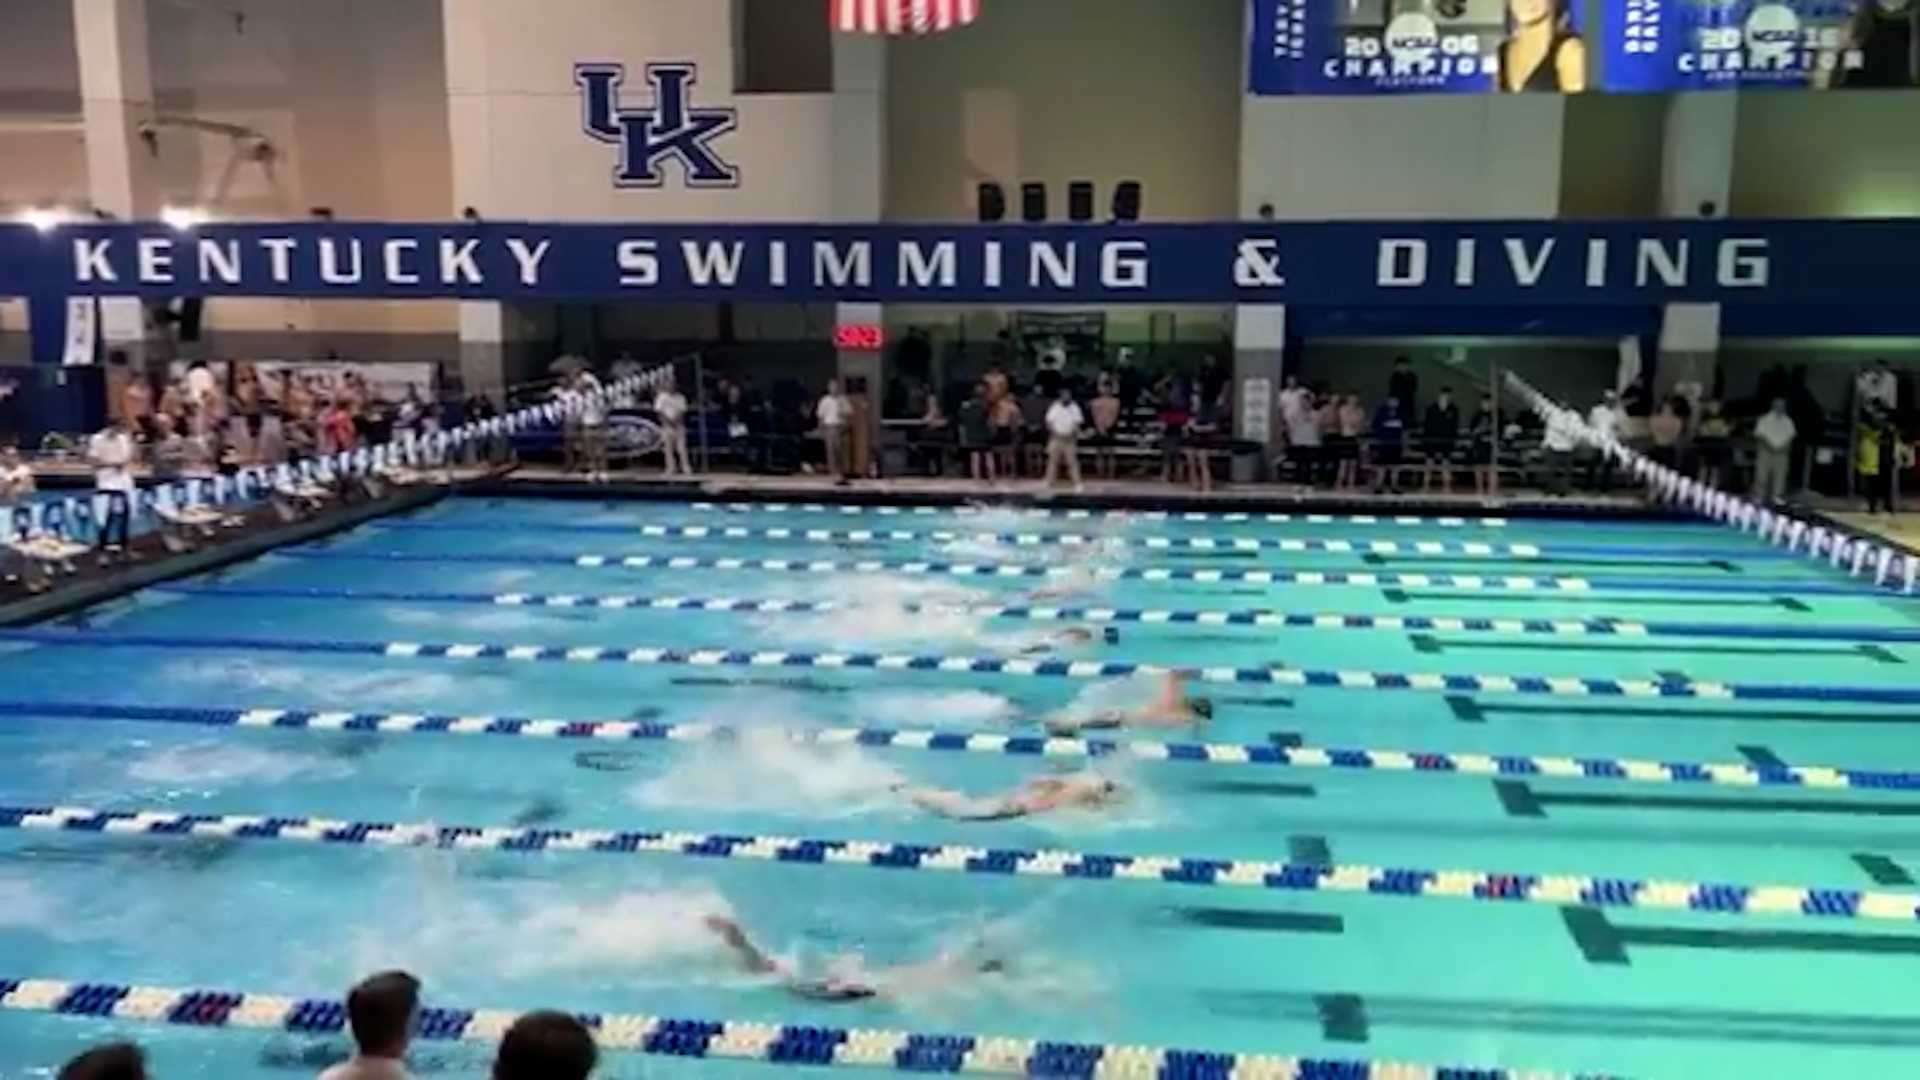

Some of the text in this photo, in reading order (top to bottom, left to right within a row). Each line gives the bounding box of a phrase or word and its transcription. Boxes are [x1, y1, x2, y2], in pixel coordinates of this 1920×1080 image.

[1323, 55, 1499, 78] CHAMPION
[1677, 49, 1864, 72] CHAMPION
[574, 63, 744, 189] UK
[73, 236, 1771, 288] KENTUCKY SWIMMING & DIVING
